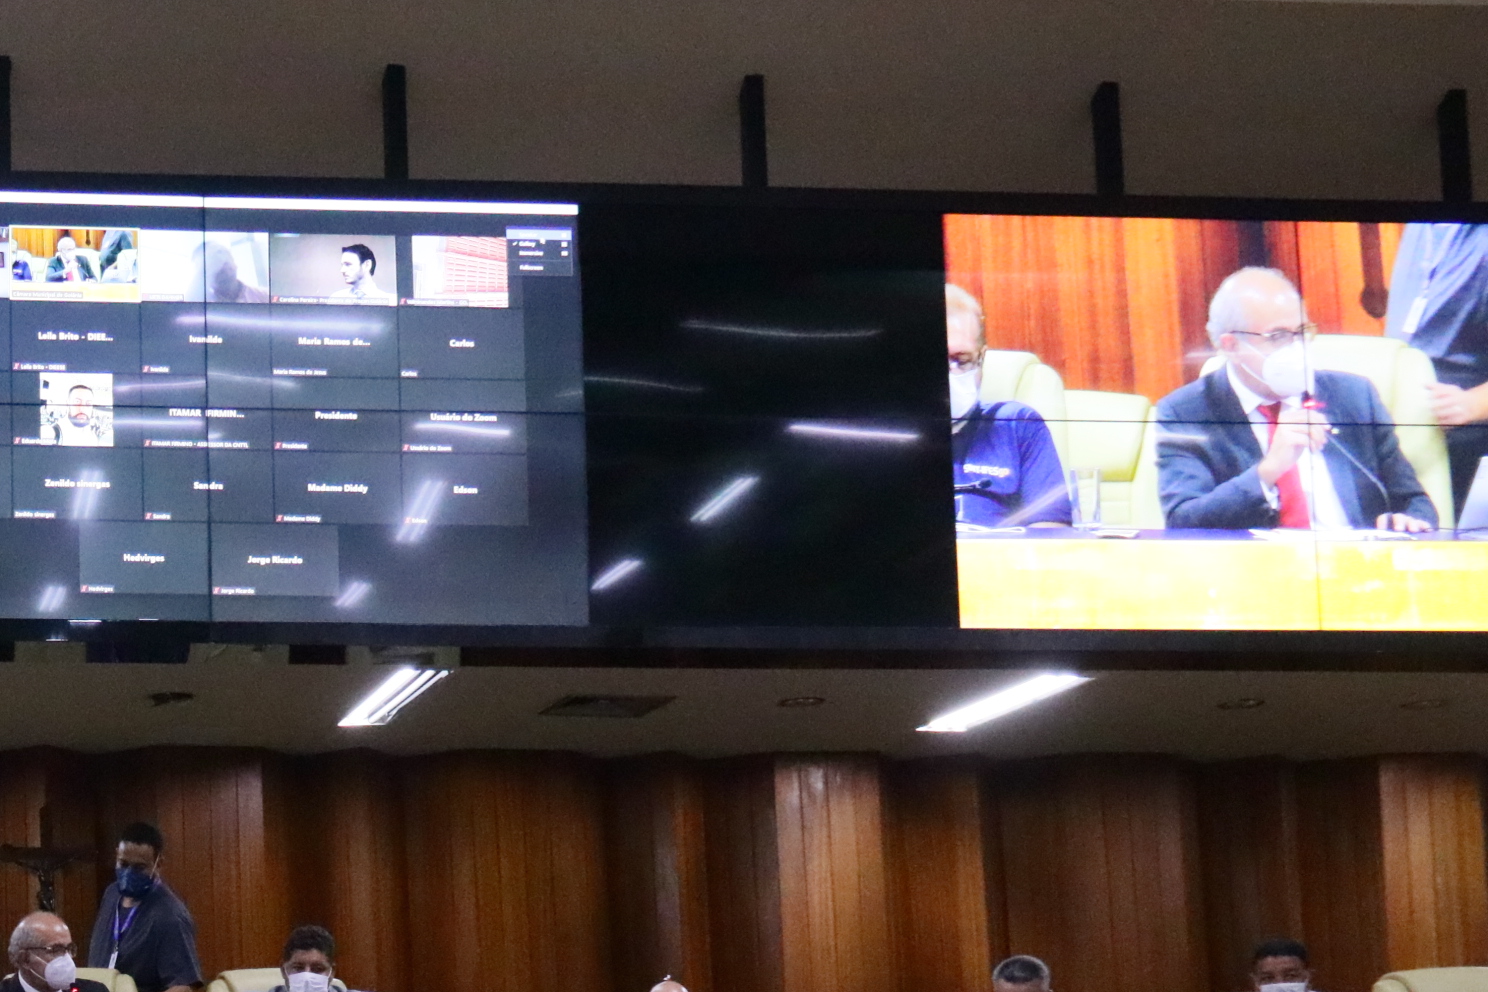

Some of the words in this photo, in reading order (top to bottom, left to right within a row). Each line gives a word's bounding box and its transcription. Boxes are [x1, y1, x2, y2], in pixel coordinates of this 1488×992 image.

[38, 331, 57, 340] Leila
[58, 332, 79, 341] Brito
[297, 337, 322, 345] Maria
[323, 337, 351, 346] Ramos
[449, 339, 475, 348] Carlos
[169, 408, 201, 417] ITAMAR
[314, 411, 358, 420] Presidente
[430, 412, 461, 421] Usuário
[461, 413, 473, 422] do
[473, 413, 498, 422] Zoom
[44, 478, 75, 488] Zenildo
[193, 481, 224, 490] Sandra
[307, 483, 343, 492] Madame
[343, 484, 369, 494] Diddy
[453, 485, 478, 494] Edson
[123, 553, 165, 564] Hedvirges
[247, 555, 271, 565] Jorge
[271, 555, 303, 565] Ricardo
